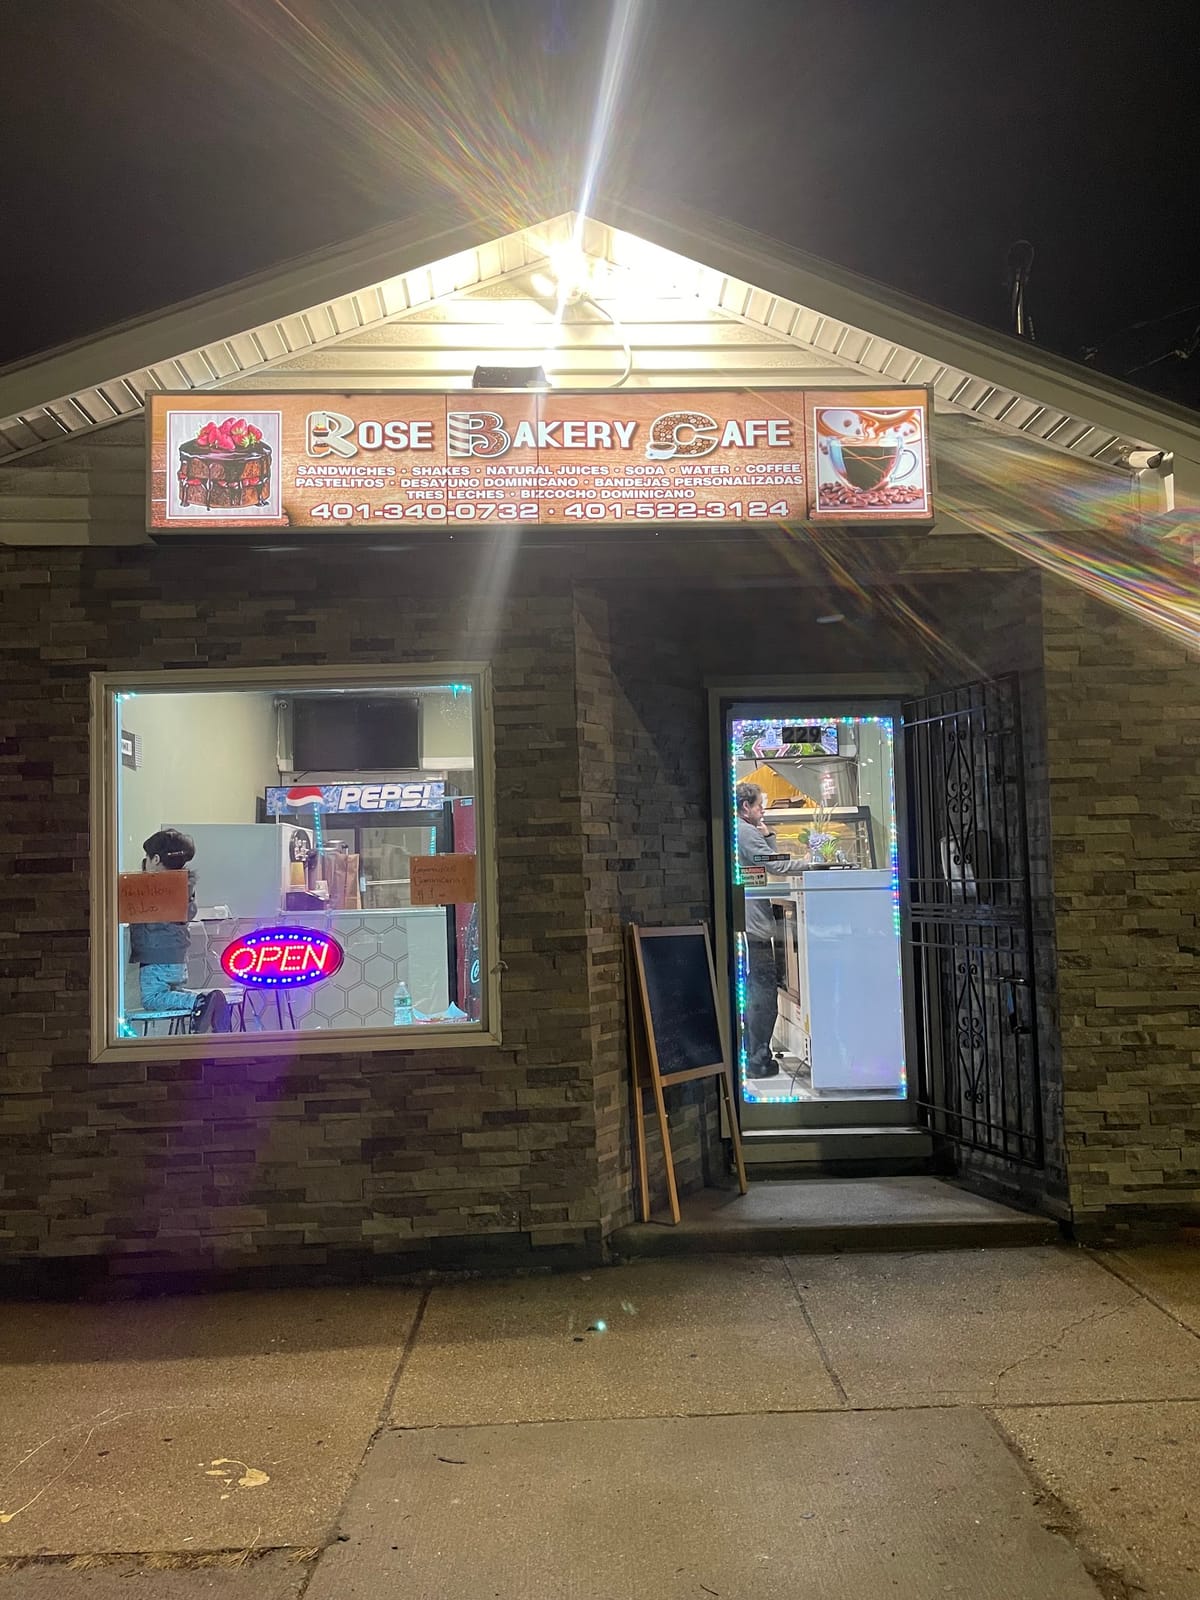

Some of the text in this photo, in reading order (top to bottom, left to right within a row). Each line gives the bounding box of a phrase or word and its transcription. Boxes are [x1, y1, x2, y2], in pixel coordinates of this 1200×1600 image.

[306, 410, 791, 459] ROSE BAKERY CAFE
[297, 463, 801, 476] SANDWICHES SHAKES NATURAL JUICES SODA WATER COFFEE
[295, 475, 803, 488] PASTELITOS DESAYUNO DOMINICANO BANDEJAS PERSONALIZADAS
[406, 488, 696, 500] TRES LECHES BIZCOCHO DOMINICANO
[310, 501, 789, 519] 401-340-0732 401-522-3124
[782, 728, 821, 743] 229
[338, 785, 432, 812] PEPSI
[229, 944, 329, 974] OPEN
